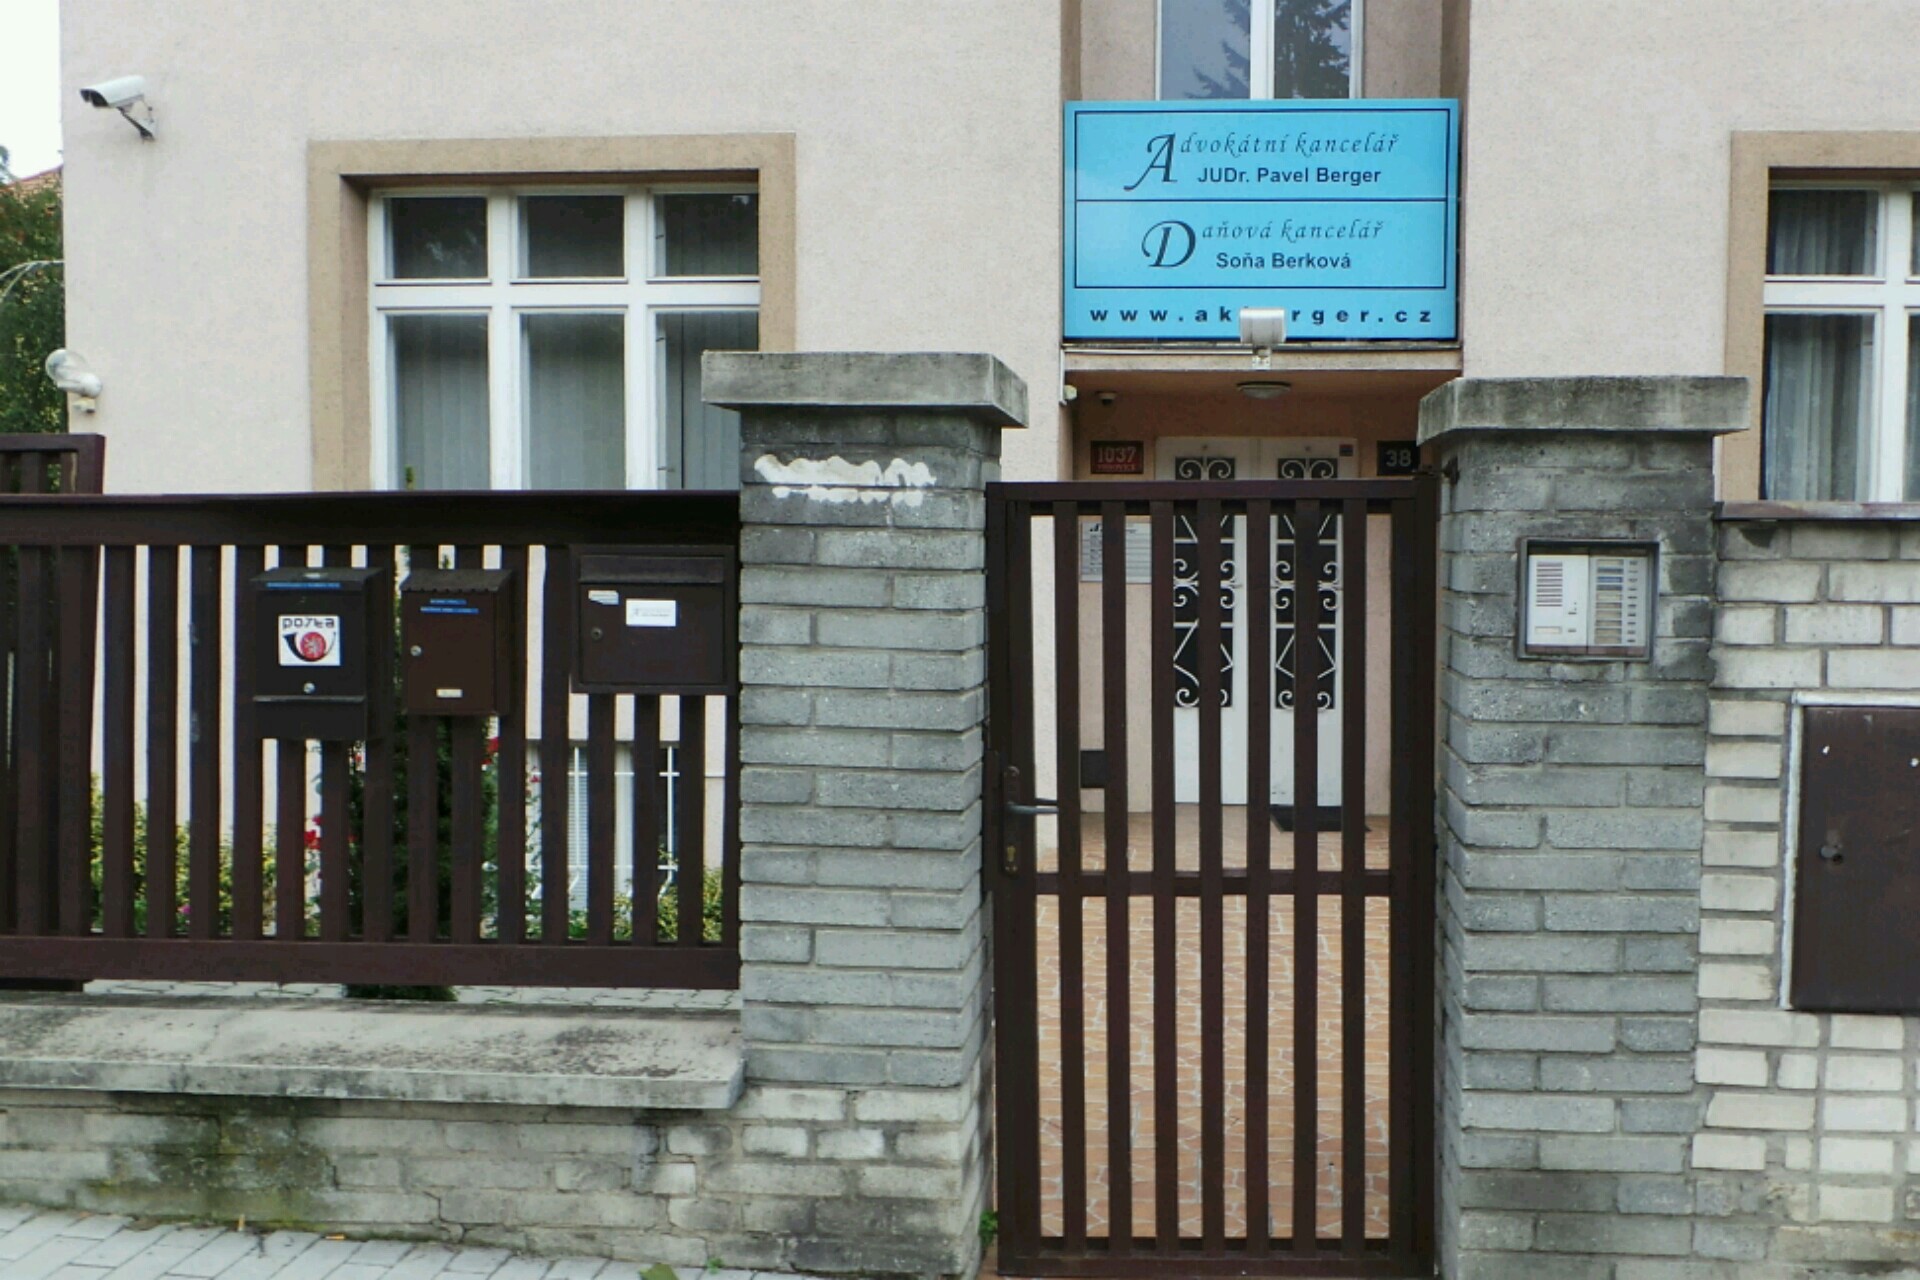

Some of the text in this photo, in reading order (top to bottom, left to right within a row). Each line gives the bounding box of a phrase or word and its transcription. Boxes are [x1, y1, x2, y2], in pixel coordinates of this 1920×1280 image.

[1123, 131, 1400, 191] Advokátní kancelář
[1197, 167, 1382, 187] JUDr. Pavel Berger
[1141, 218, 1384, 268] Daňová kancelář
[1216, 252, 1351, 269] Soňa Berková
[1090, 306, 1432, 325] www.akrger.cz
[1097, 446, 1137, 463] 1037
[1385, 449, 1412, 467] 38
